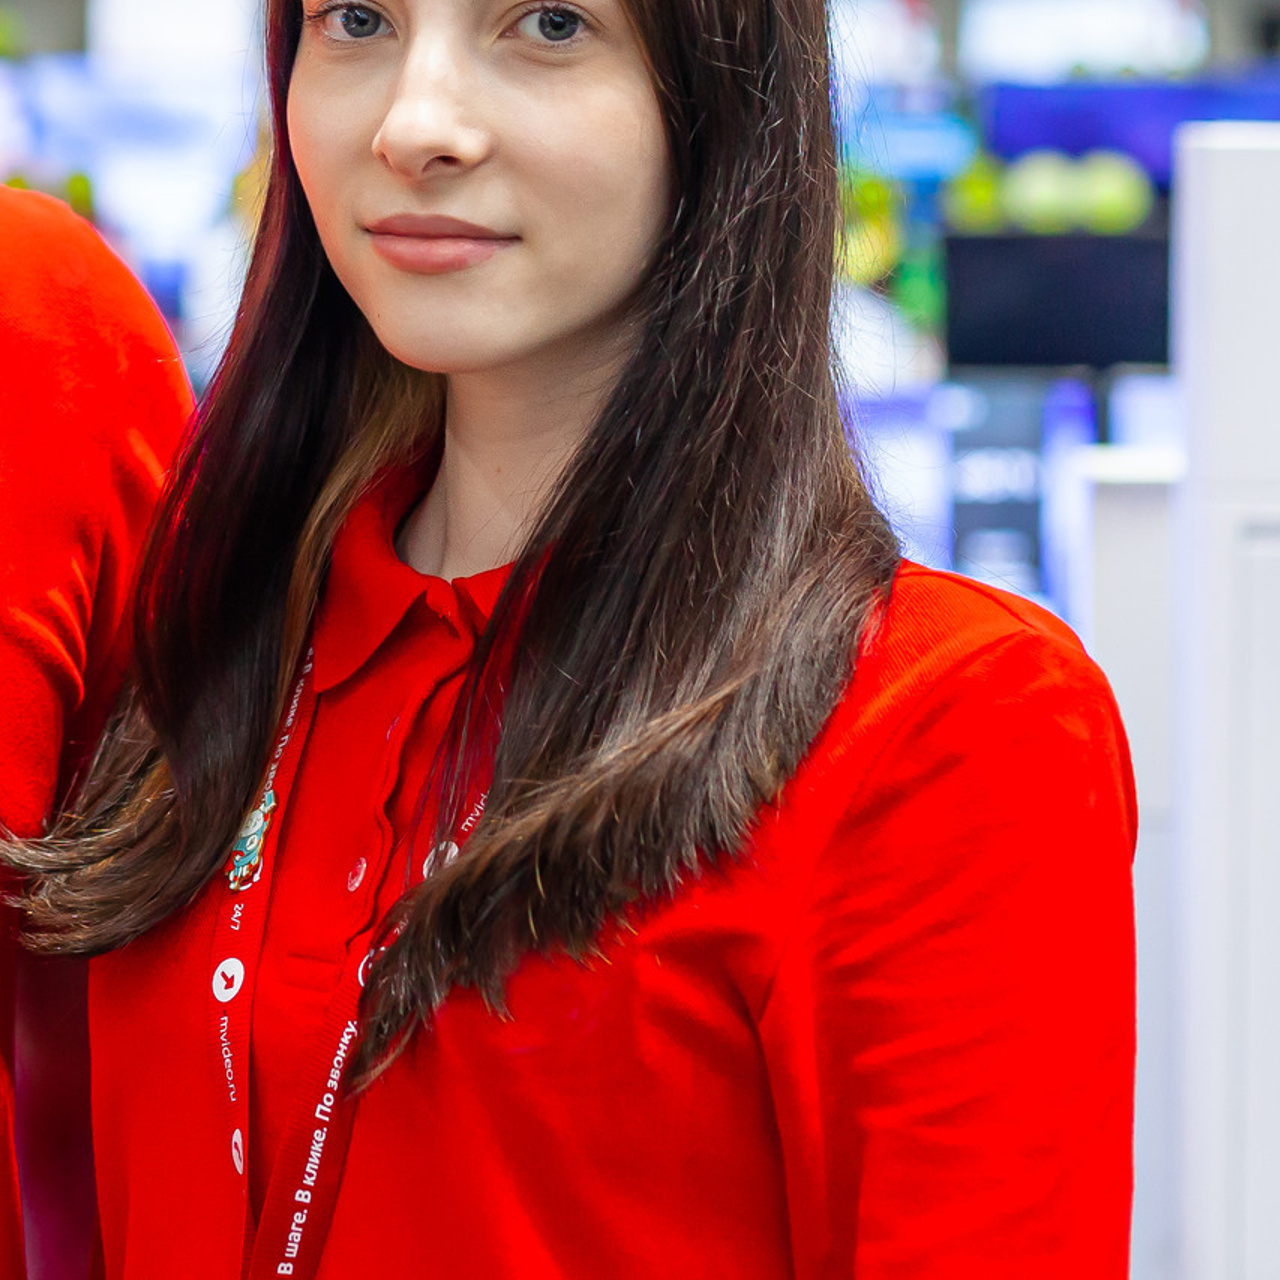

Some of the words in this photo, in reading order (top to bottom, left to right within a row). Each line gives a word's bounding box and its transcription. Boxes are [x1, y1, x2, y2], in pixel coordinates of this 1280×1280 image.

[460, 790, 489, 832] mvid
[230, 903, 244, 931] 24/7
[220, 1016, 237, 1102] mvideo.ru
[326, 1020, 358, 1091] звонку.
[314, 1092, 335, 1122] По
[302, 1126, 327, 1187] клике.
[294, 1188, 312, 1204] В
[284, 1208, 308, 1258] шаге.
[277, 1261, 294, 1276] В
